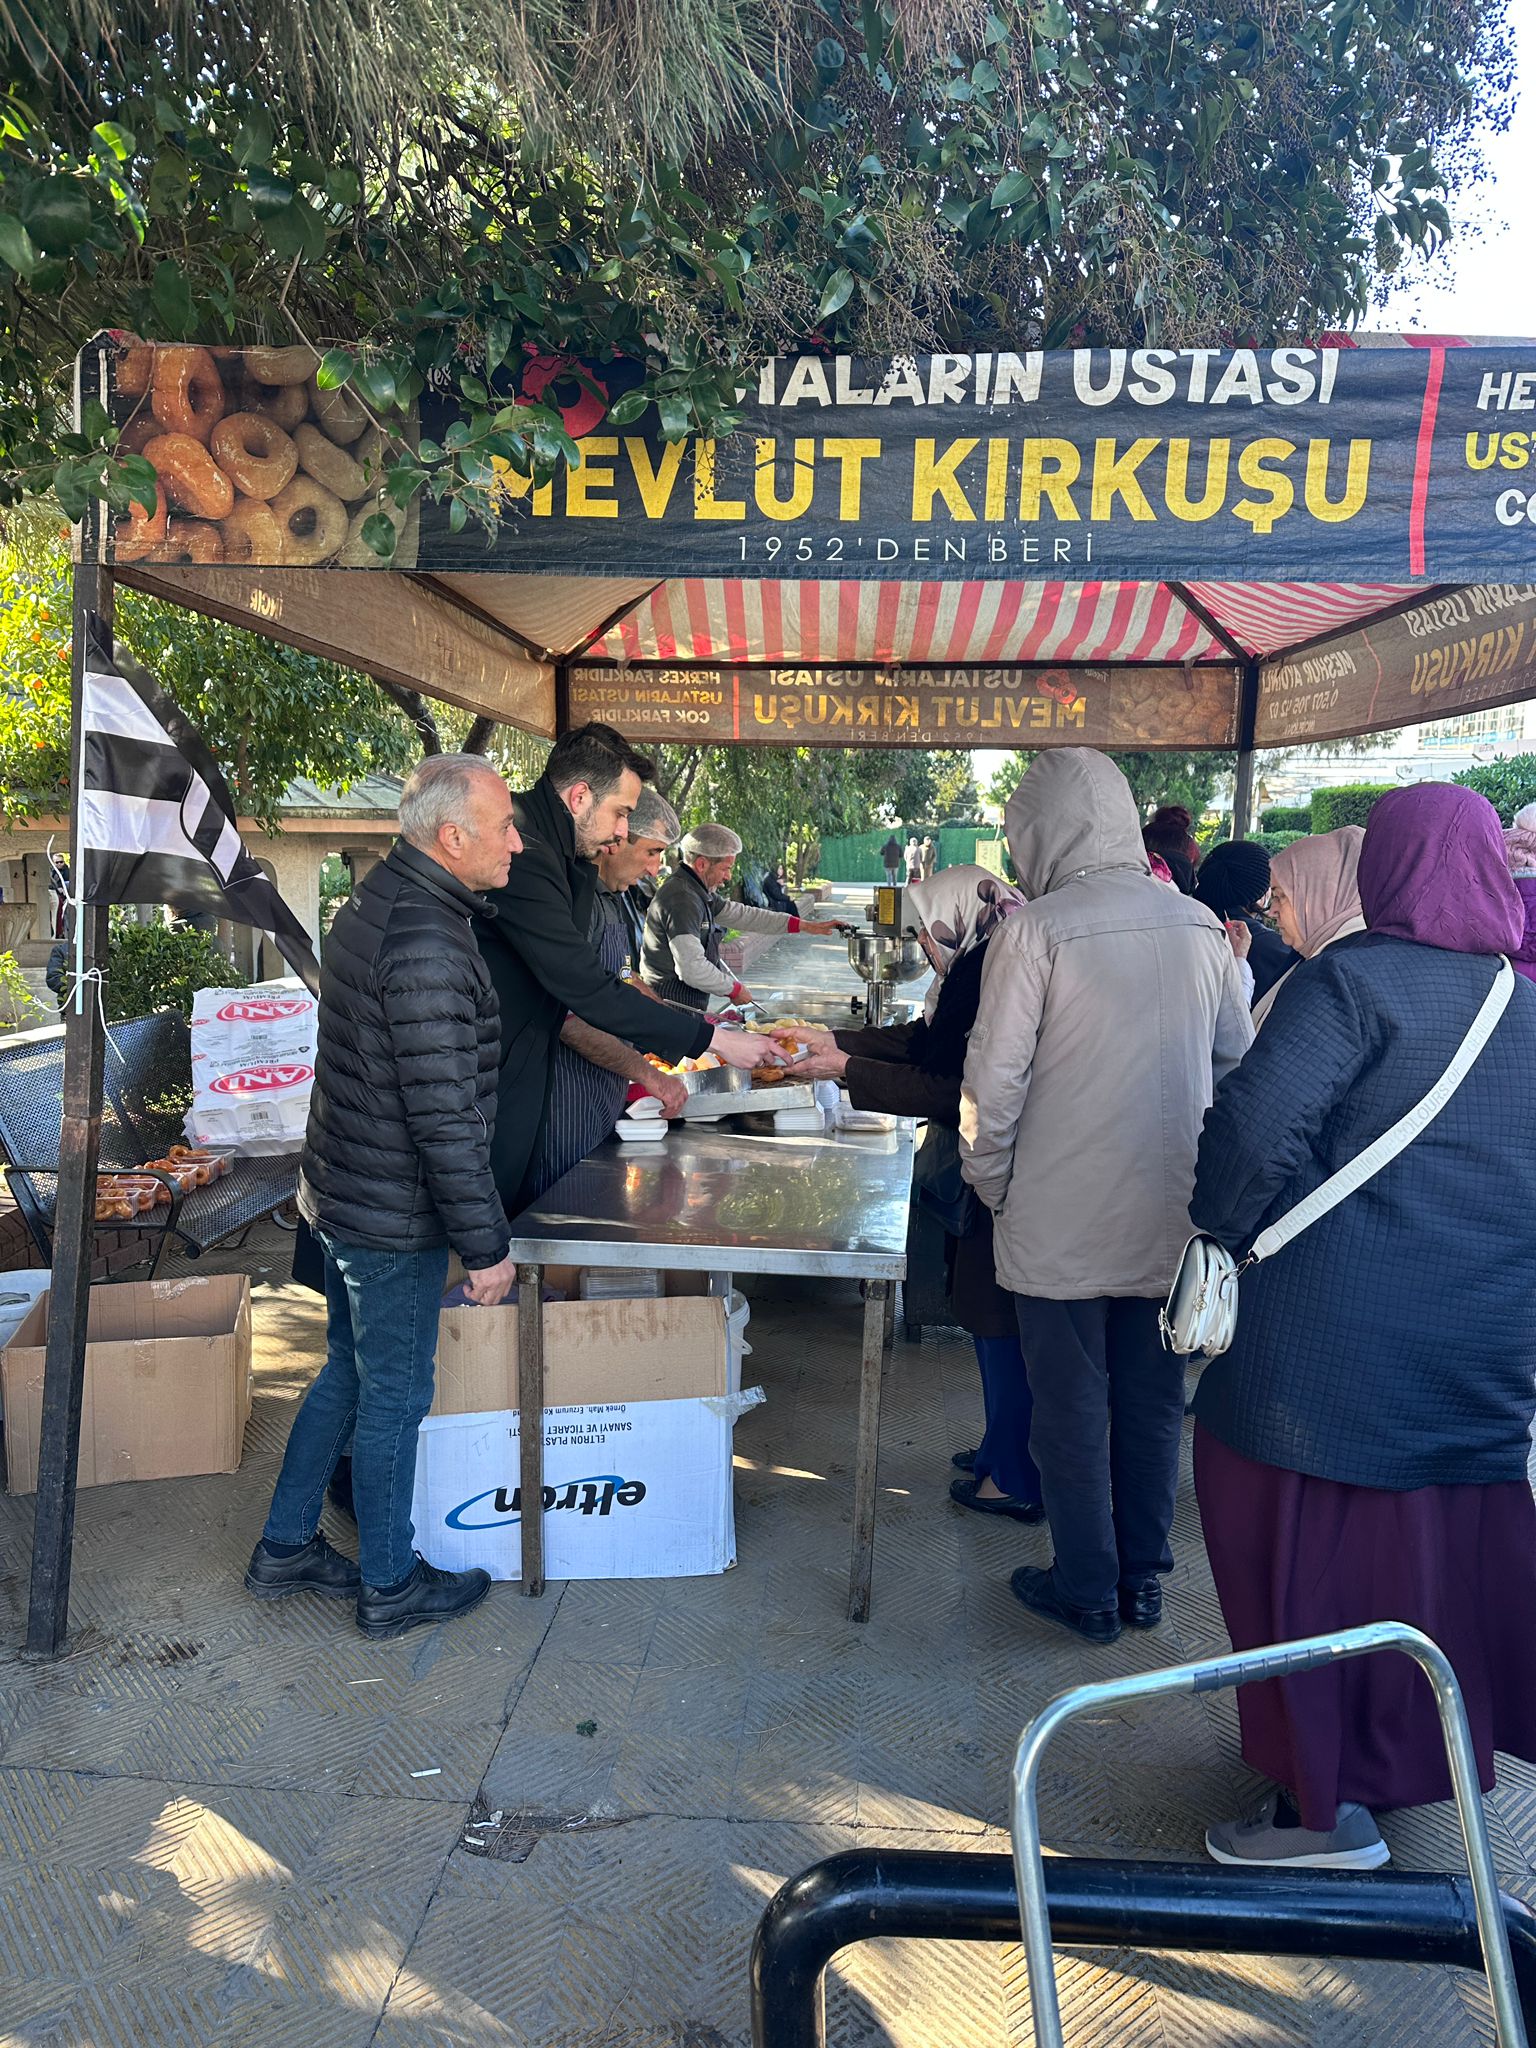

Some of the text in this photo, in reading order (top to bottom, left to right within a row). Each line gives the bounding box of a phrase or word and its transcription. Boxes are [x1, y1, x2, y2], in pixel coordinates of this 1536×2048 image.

[733, 348, 1340, 406] TALARIN USTASI
[1465, 431, 1536, 470] US
[911, 437, 1373, 533] KIRKUŞU
[1495, 488, 1536, 526] C
[738, 532, 1093, 562] 1952'DEN BERİ
[555, 1407, 584, 1415] Erzurum
[586, 1405, 604, 1414] Mah.
[605, 1404, 626, 1413] Örnek
[547, 1424, 583, 1436] TİCARET
[586, 1424, 598, 1433] VE
[600, 1422, 632, 1433] SANAYİ
[543, 1434, 606, 1446] ELTRON PLAS
